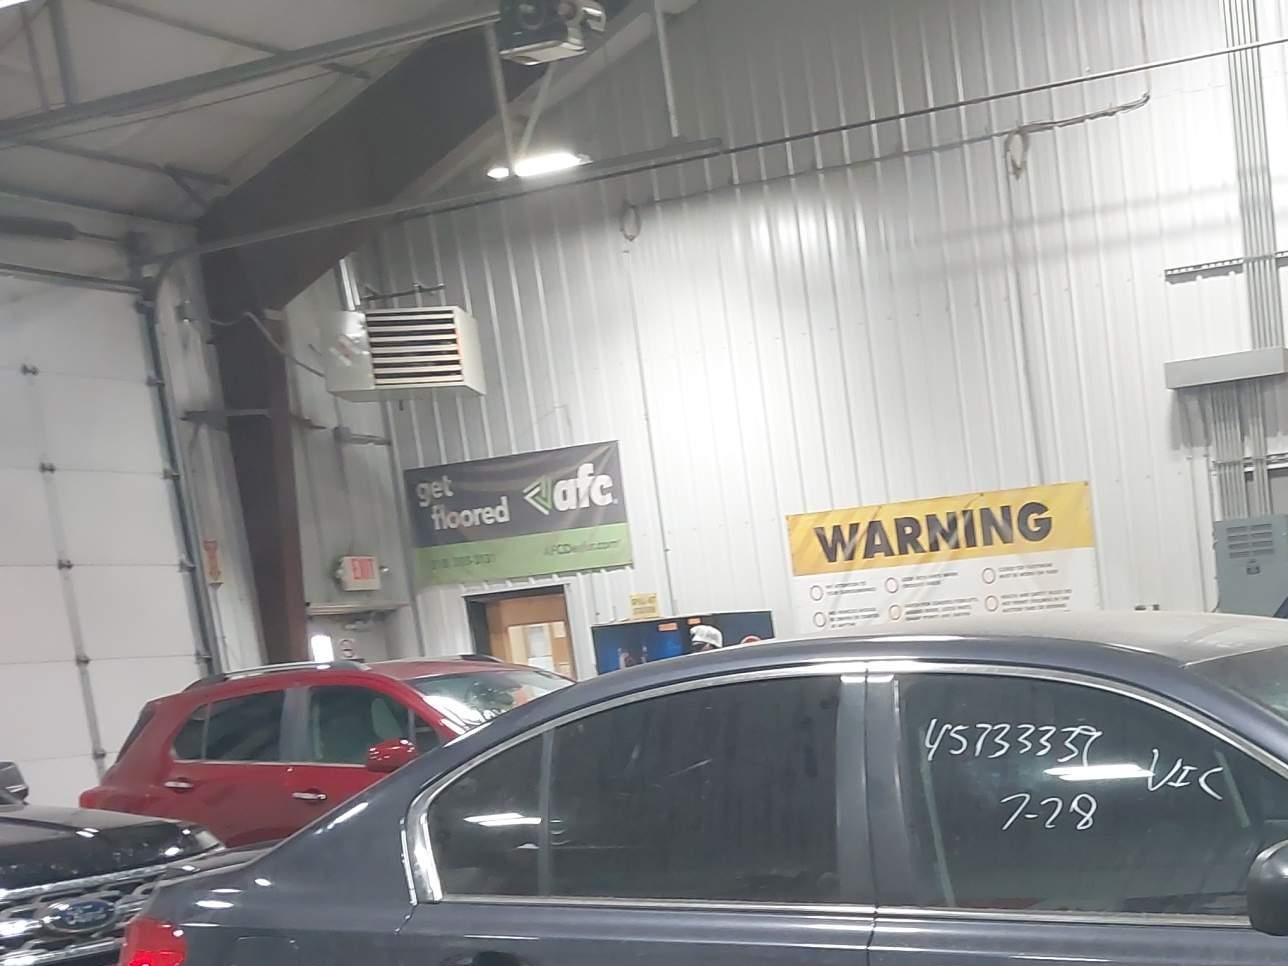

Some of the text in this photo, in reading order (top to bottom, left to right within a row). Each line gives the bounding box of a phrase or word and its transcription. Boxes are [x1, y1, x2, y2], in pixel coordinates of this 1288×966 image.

[416, 475, 453, 507] get
[554, 463, 613, 512] afc
[431, 496, 511, 530] floored
[814, 501, 1053, 563] WARNING
[1000, 793, 1098, 831] 7-28
